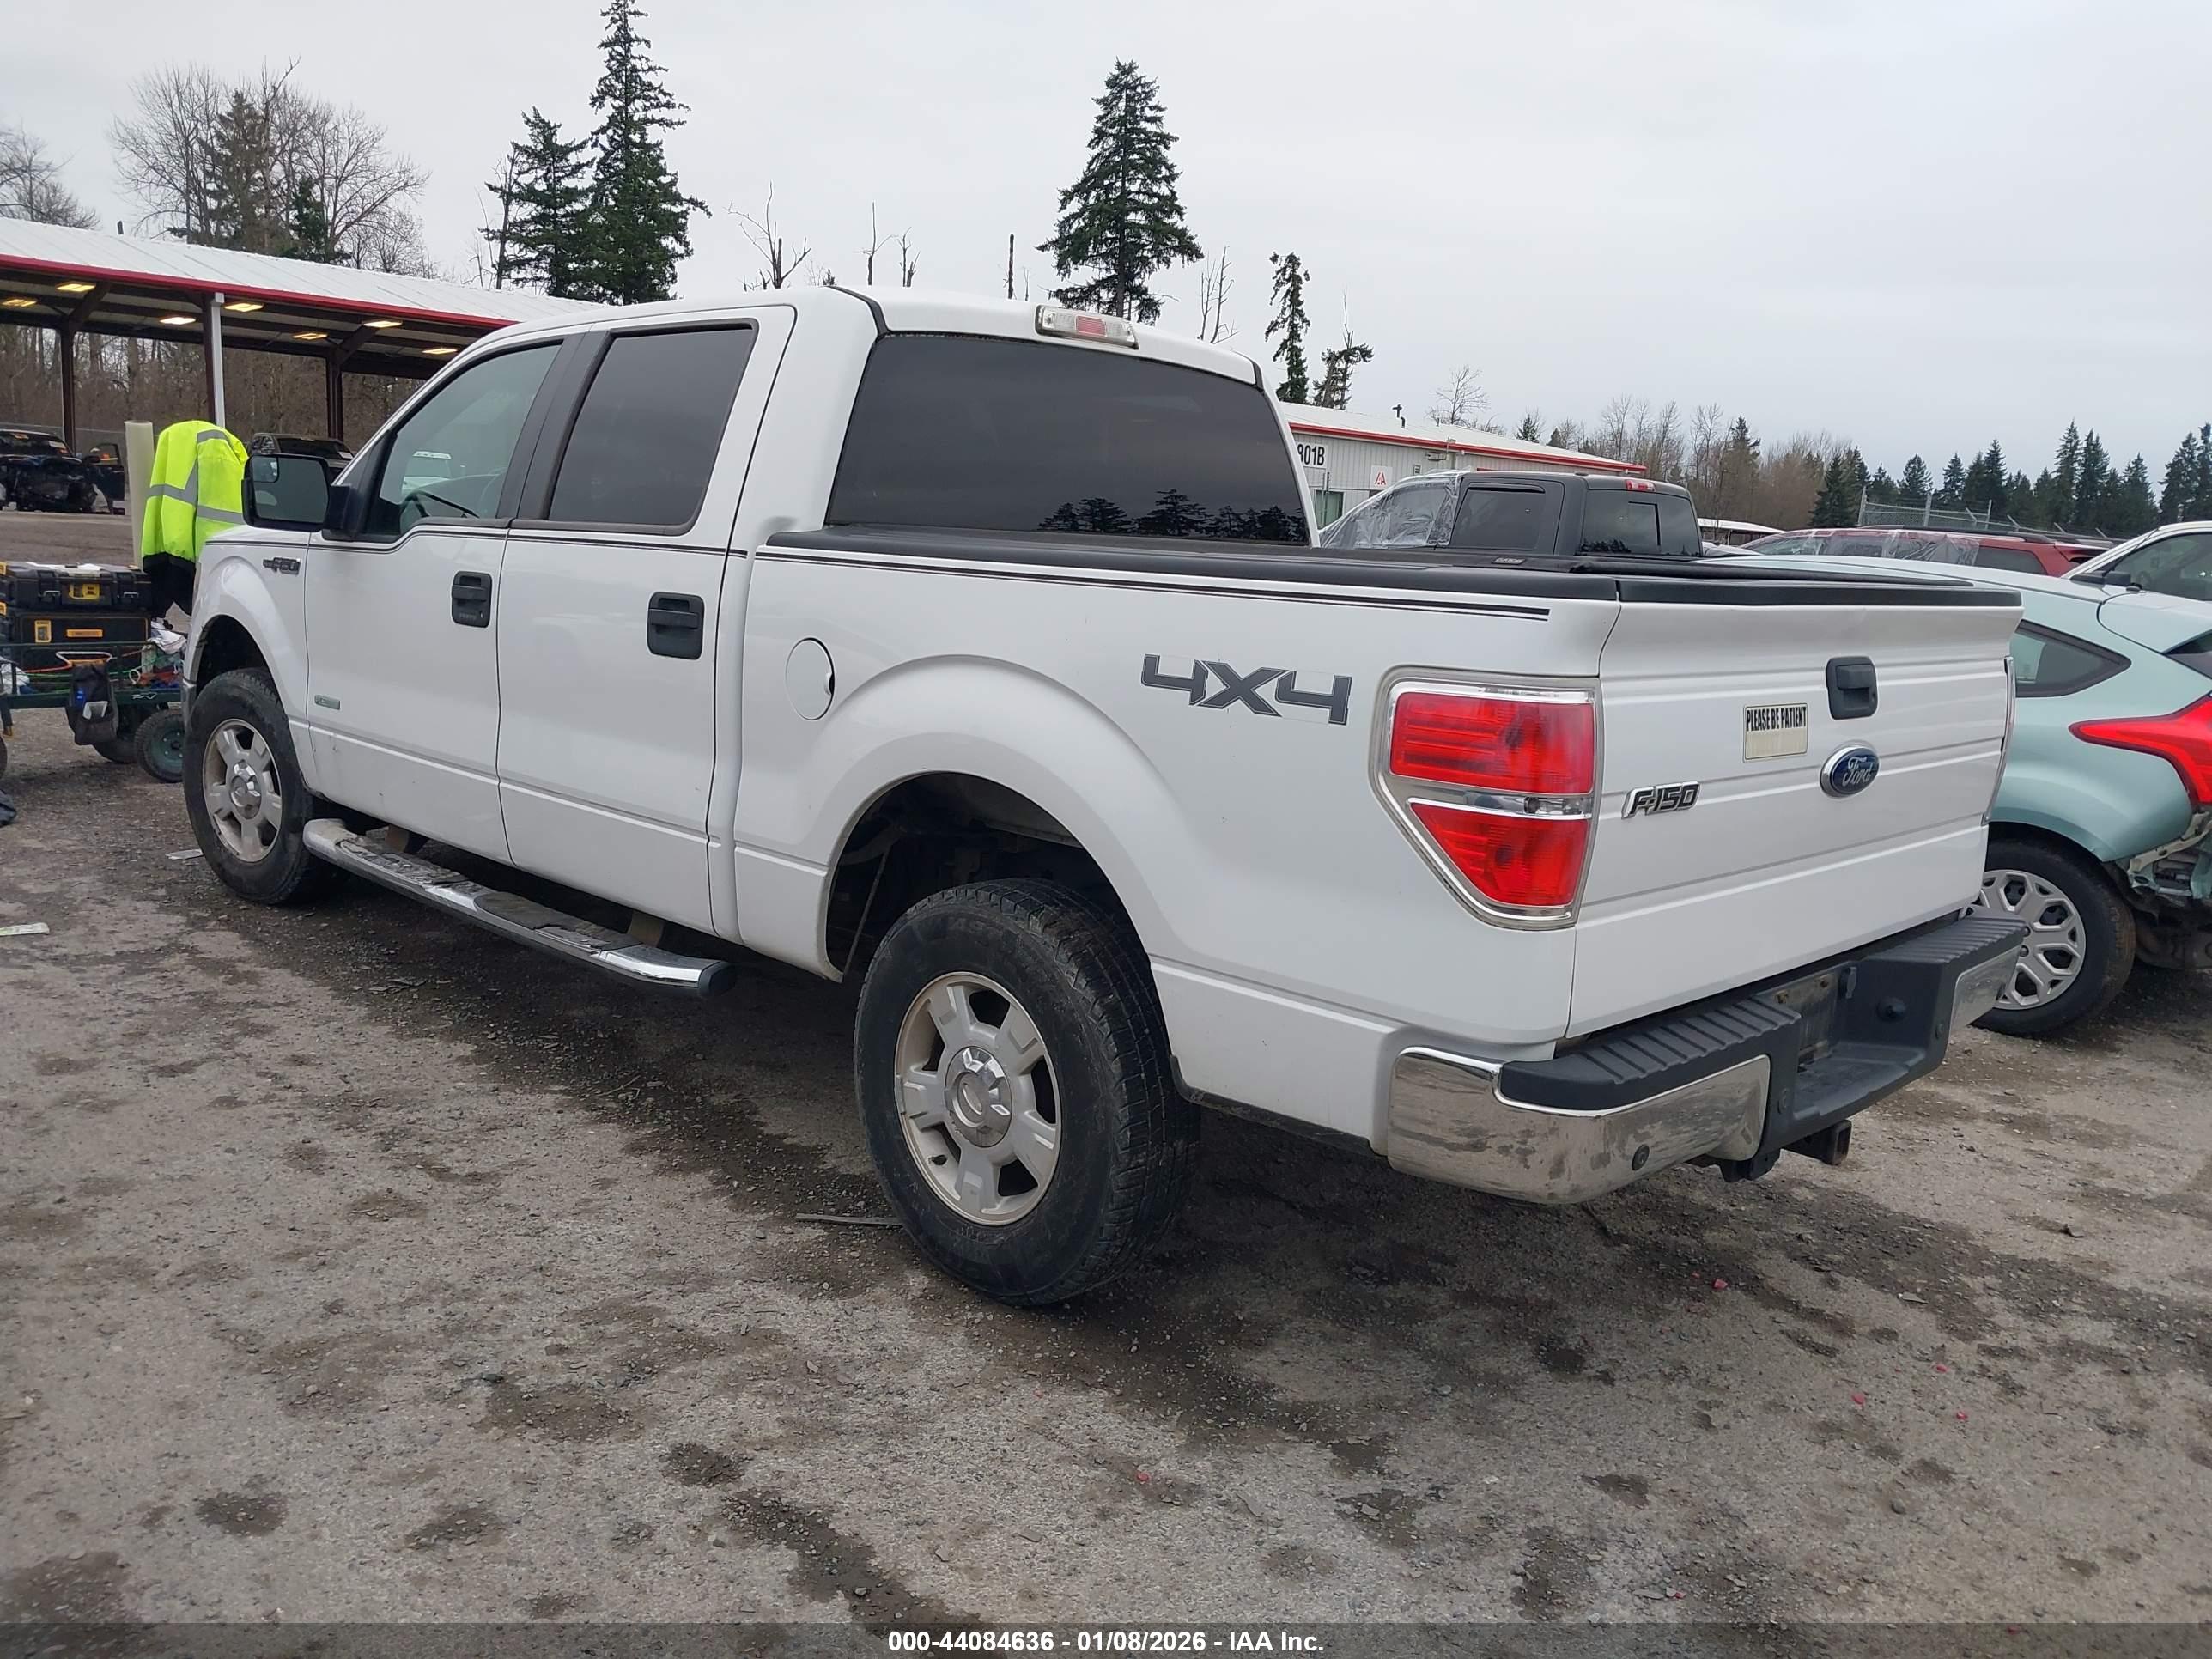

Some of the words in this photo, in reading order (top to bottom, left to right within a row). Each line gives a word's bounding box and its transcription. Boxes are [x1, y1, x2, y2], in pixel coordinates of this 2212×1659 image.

[1140, 653, 1353, 726] 4X4
[1746, 708, 1771, 732] PLEASE
[1771, 708, 1780, 730] BE
[1780, 706, 1807, 728] PATIENT
[1842, 756, 1874, 787] Ford
[1621, 781, 1699, 819] F-150
